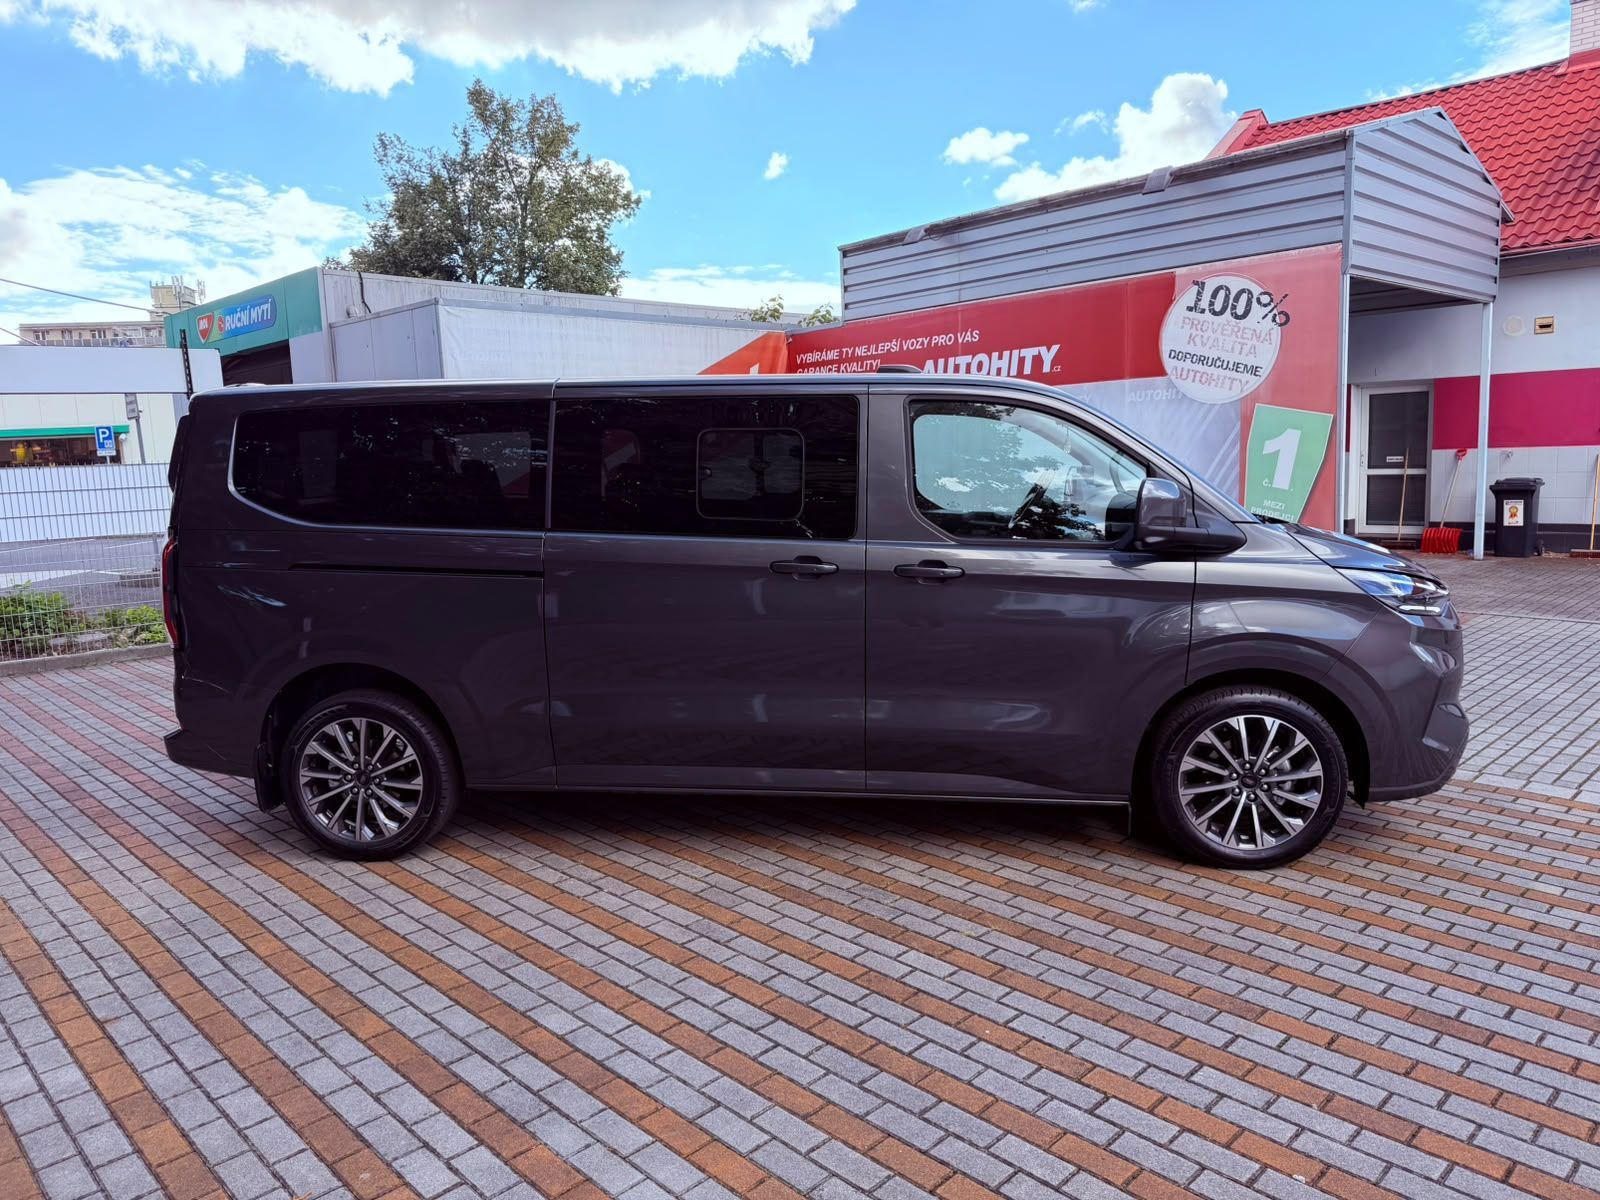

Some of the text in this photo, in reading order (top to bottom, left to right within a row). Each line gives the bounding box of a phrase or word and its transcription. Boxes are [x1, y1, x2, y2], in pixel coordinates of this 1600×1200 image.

[225, 299, 272, 331] RUČNÍ MYTÍ
[1186, 280, 1290, 327] 100%
[1180, 316, 1273, 345] PROVĚŘENÁ
[796, 328, 980, 365] VYBÍRÁME TY NEJLEPŠÍ VOZY PRO VÁS
[1188, 333, 1257, 358] KVALITA
[1168, 348, 1264, 378] DOPORUČUJEME
[1170, 365, 1249, 393] AUTOHITY
[98, 429, 109, 442] P
